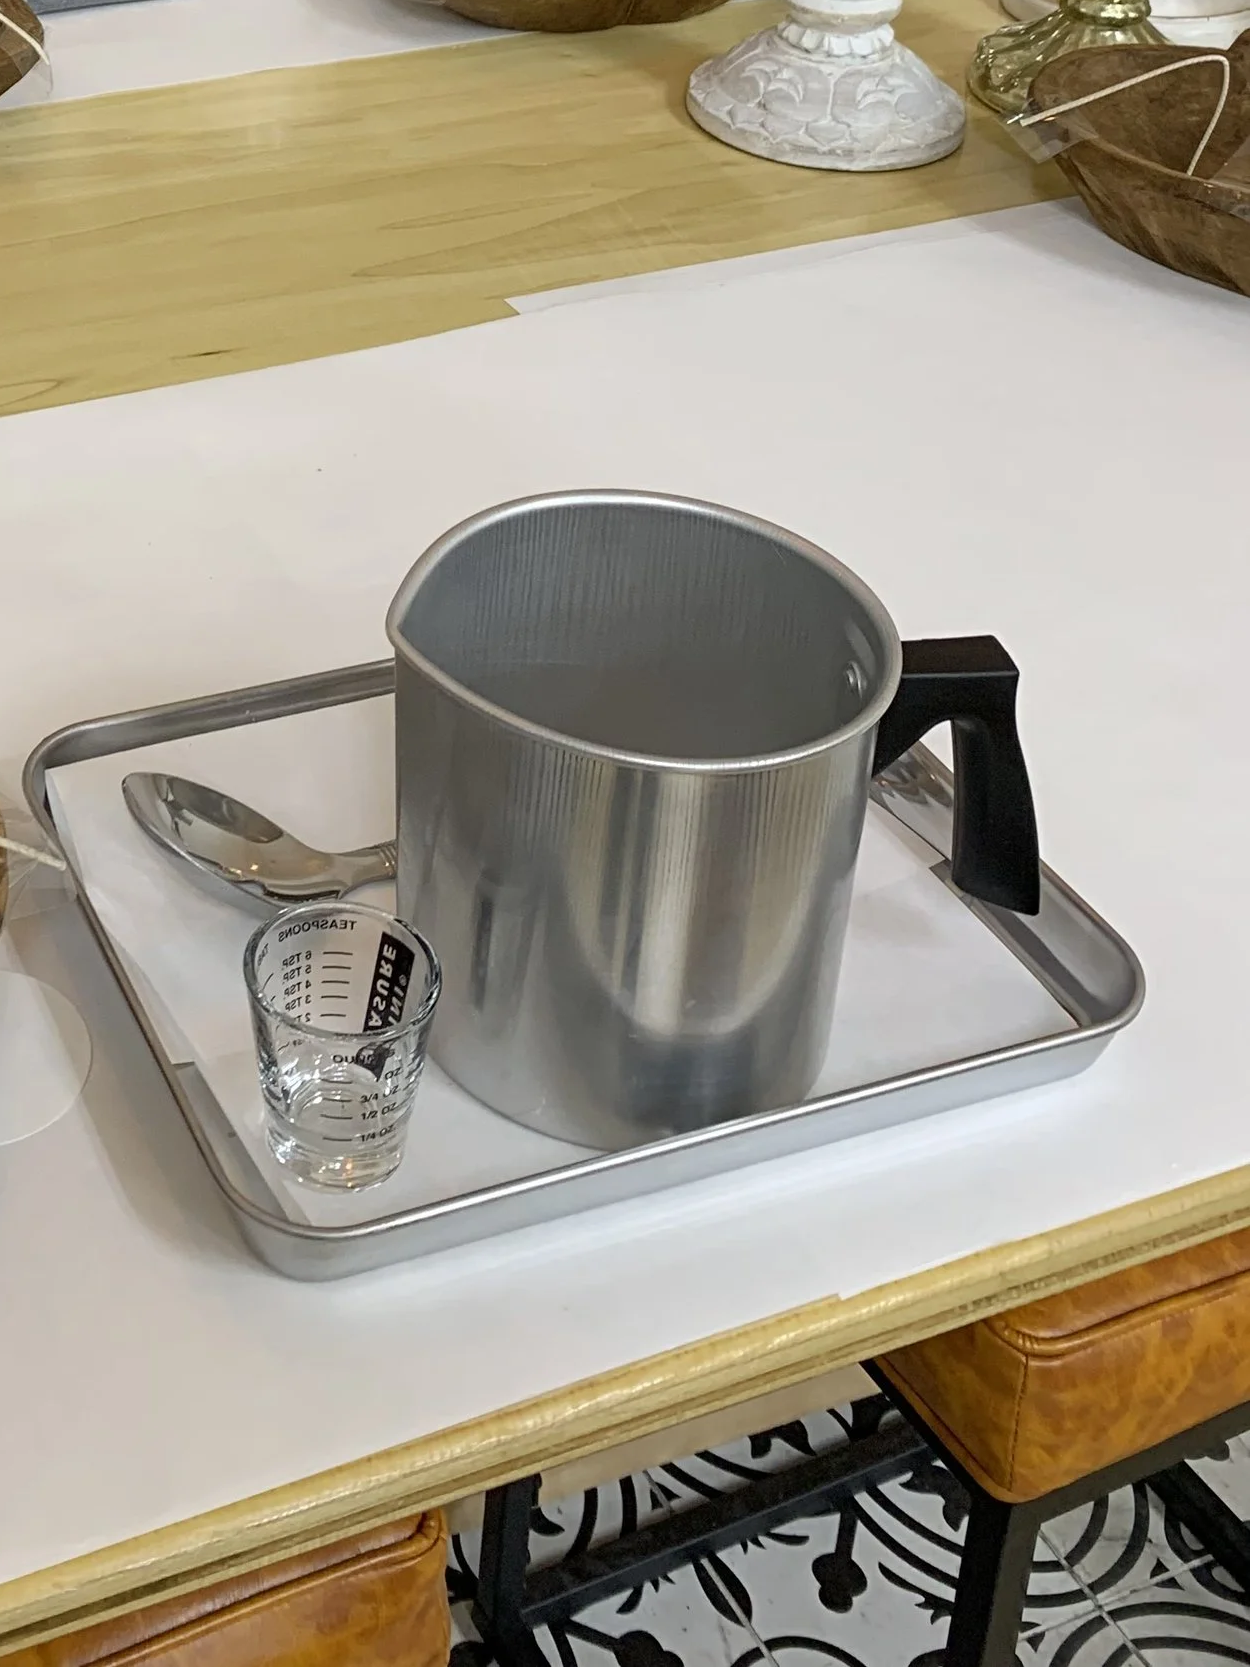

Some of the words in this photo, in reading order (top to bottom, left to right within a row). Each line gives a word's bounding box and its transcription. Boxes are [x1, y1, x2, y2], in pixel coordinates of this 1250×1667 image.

[360, 1093, 378, 1104] 3/4
[361, 1110, 378, 1121] 1/2
[361, 1132, 376, 1143] 1/4
